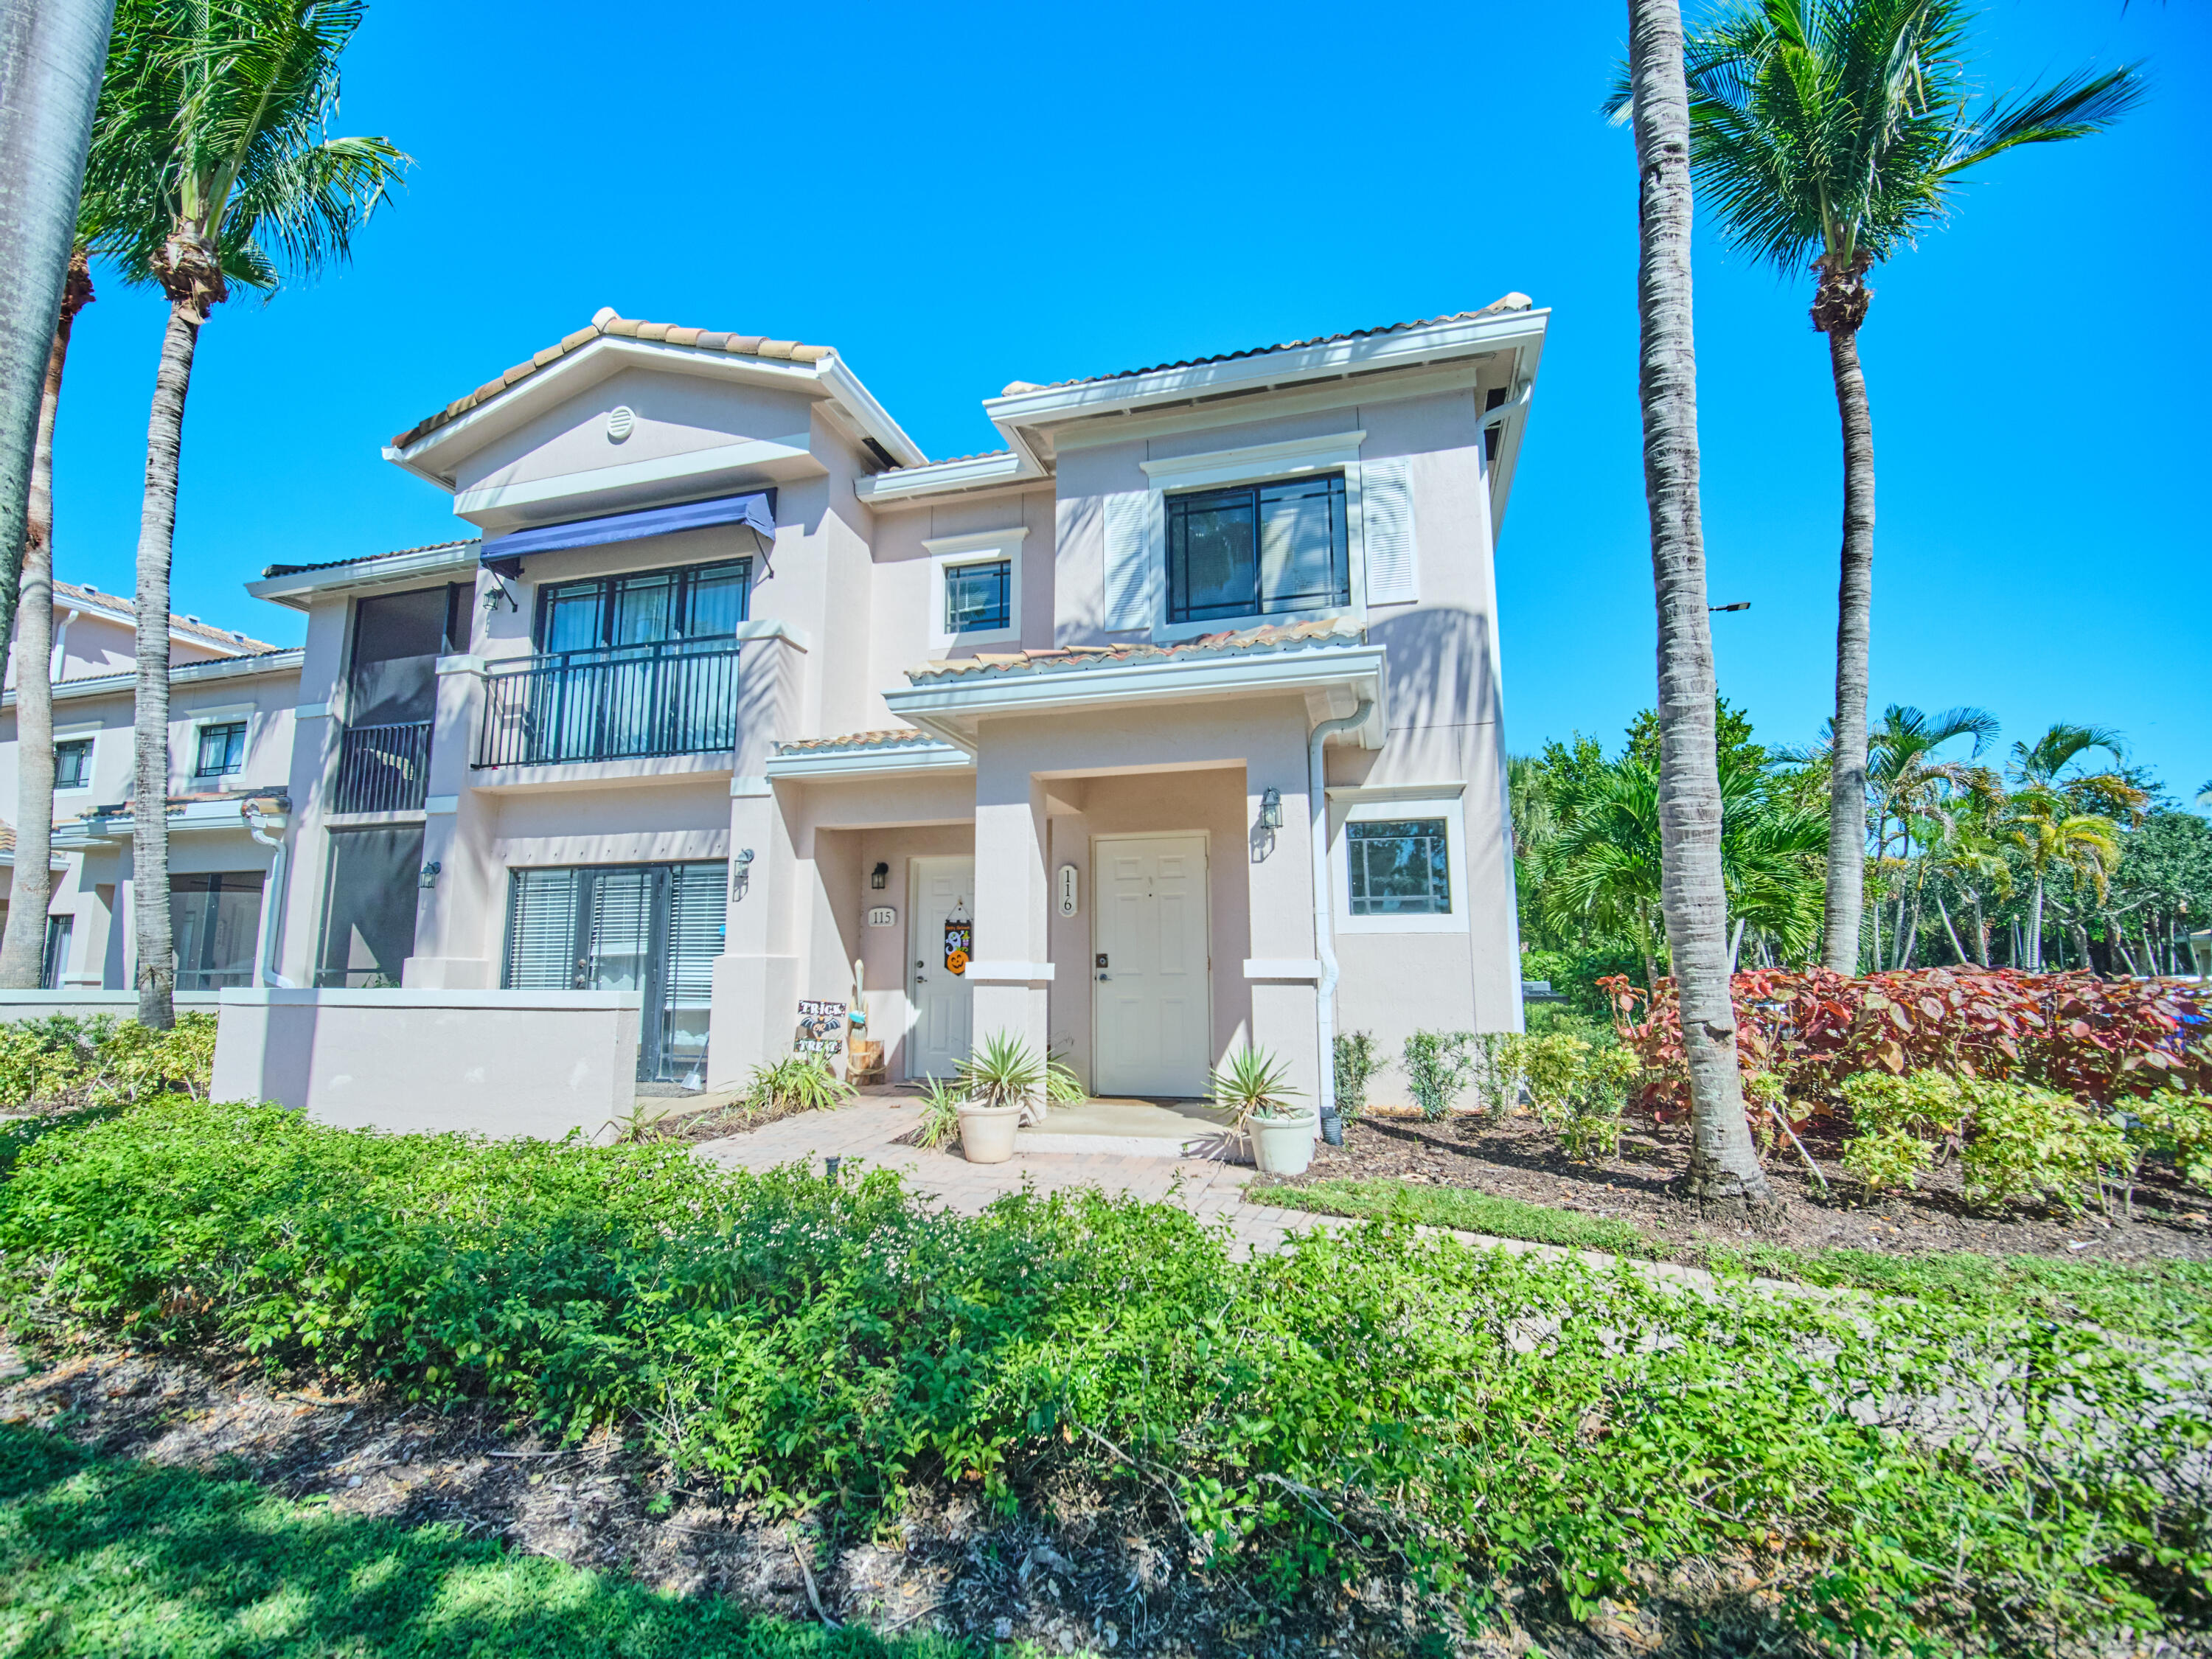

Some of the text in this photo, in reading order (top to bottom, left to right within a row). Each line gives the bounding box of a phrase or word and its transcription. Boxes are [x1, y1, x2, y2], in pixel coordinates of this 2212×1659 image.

[1064, 869, 1072, 911] 116
[874, 911, 891, 923] 115
[813, 1023, 826, 1032] OR
